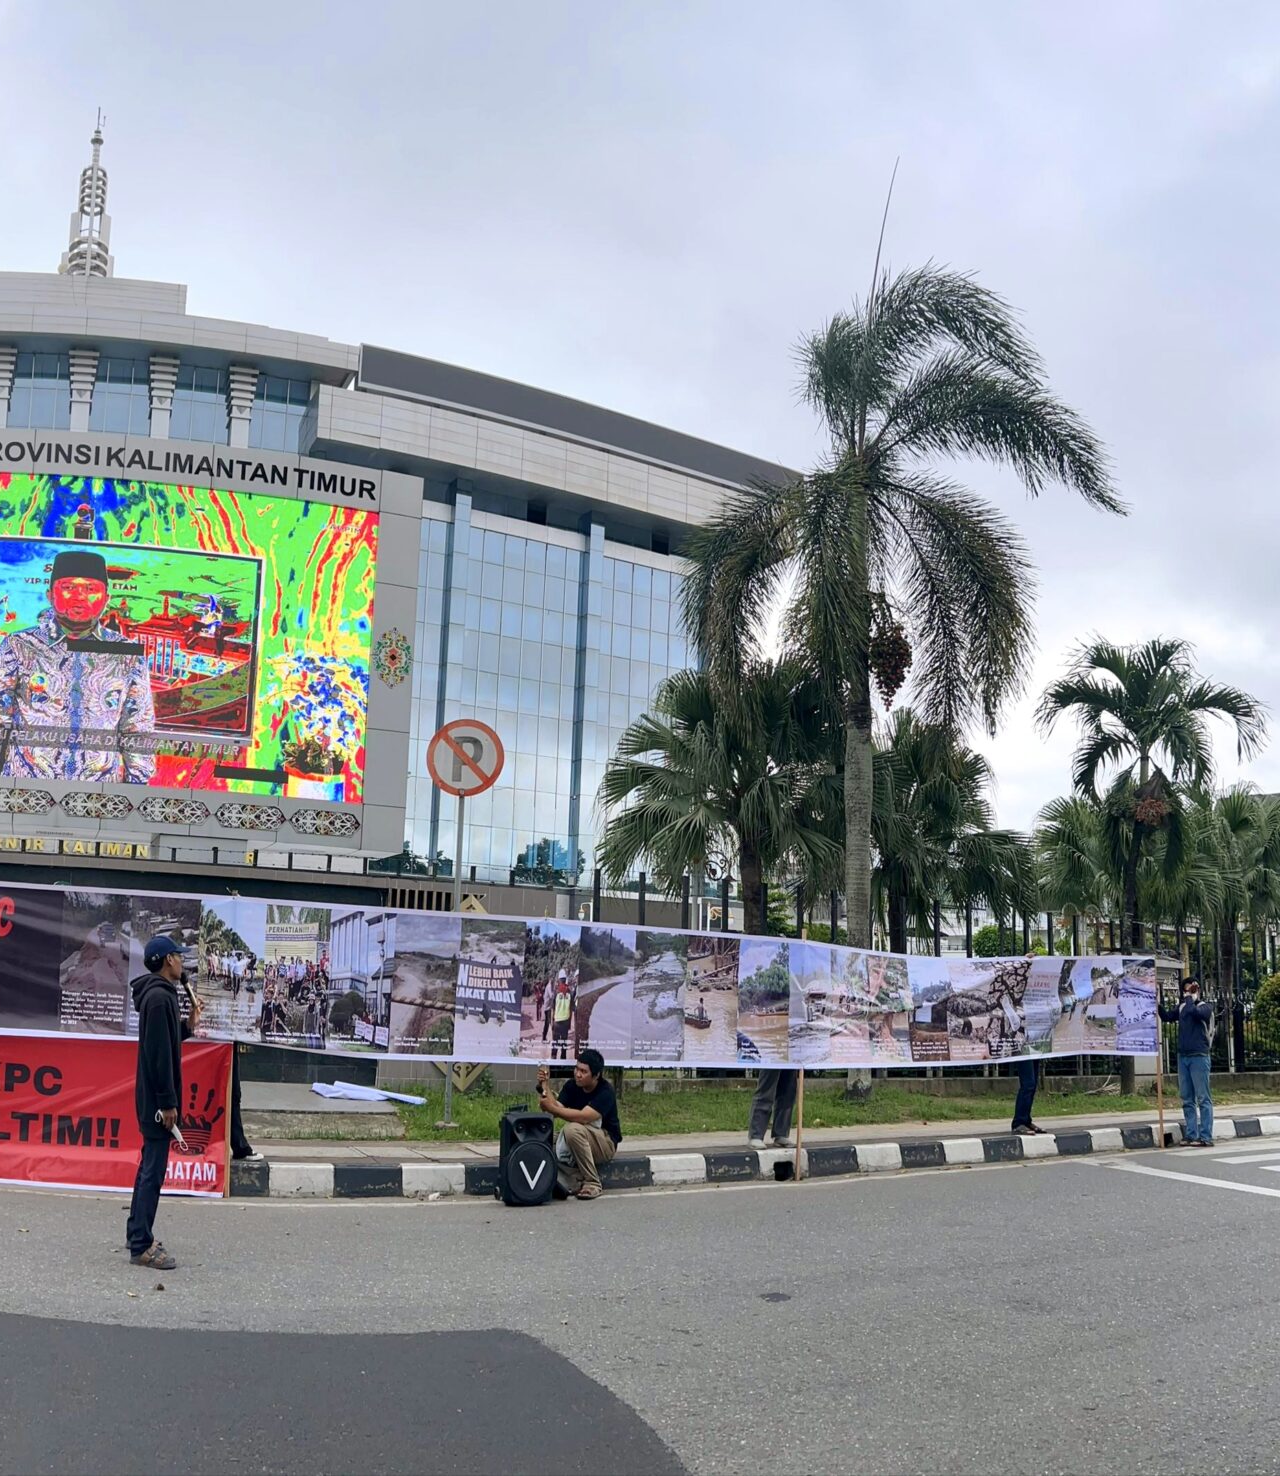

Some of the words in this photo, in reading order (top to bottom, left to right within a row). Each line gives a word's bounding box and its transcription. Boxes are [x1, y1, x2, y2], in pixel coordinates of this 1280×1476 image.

[106, 446, 288, 486] KALIMANTAN
[293, 467, 376, 500] TIMUR
[10, 730, 57, 742] PELAKU
[60, 732, 101, 745] USAHA
[121, 736, 199, 752] KALIMANTAN
[203, 743, 240, 756] TIMUR
[469, 965, 492, 979] LEBIH
[492, 968, 514, 979] BAIK
[468, 976, 509, 989] DIKELOLA
[488, 989, 516, 1004] ADAT
[165, 1161, 217, 1181] HATAM
[519, 1160, 546, 1190] V
